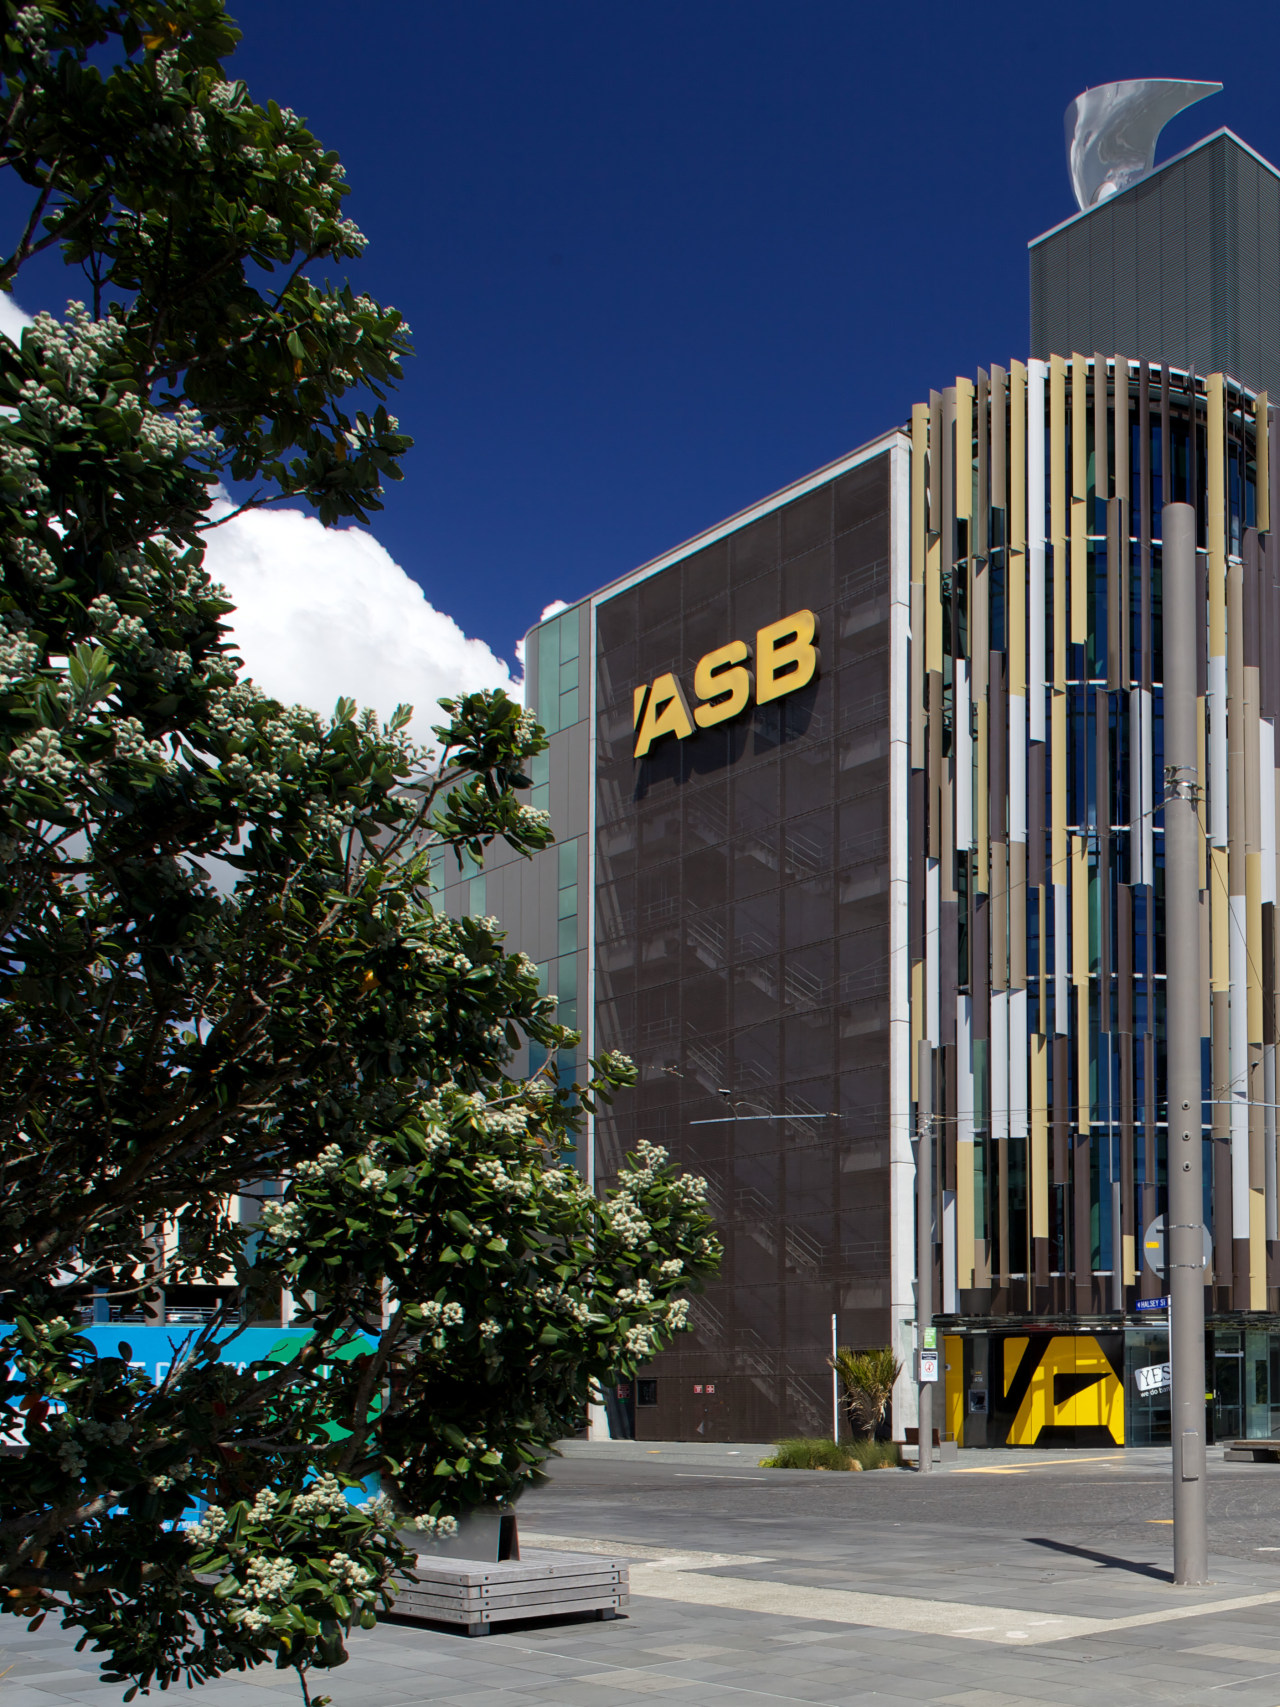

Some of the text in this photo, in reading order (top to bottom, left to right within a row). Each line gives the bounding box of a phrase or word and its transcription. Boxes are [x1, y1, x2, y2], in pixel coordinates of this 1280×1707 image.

[634, 609, 819, 759] ASB
[1140, 1300, 1159, 1308] HALSEY
[1140, 1366, 1170, 1386] YES
